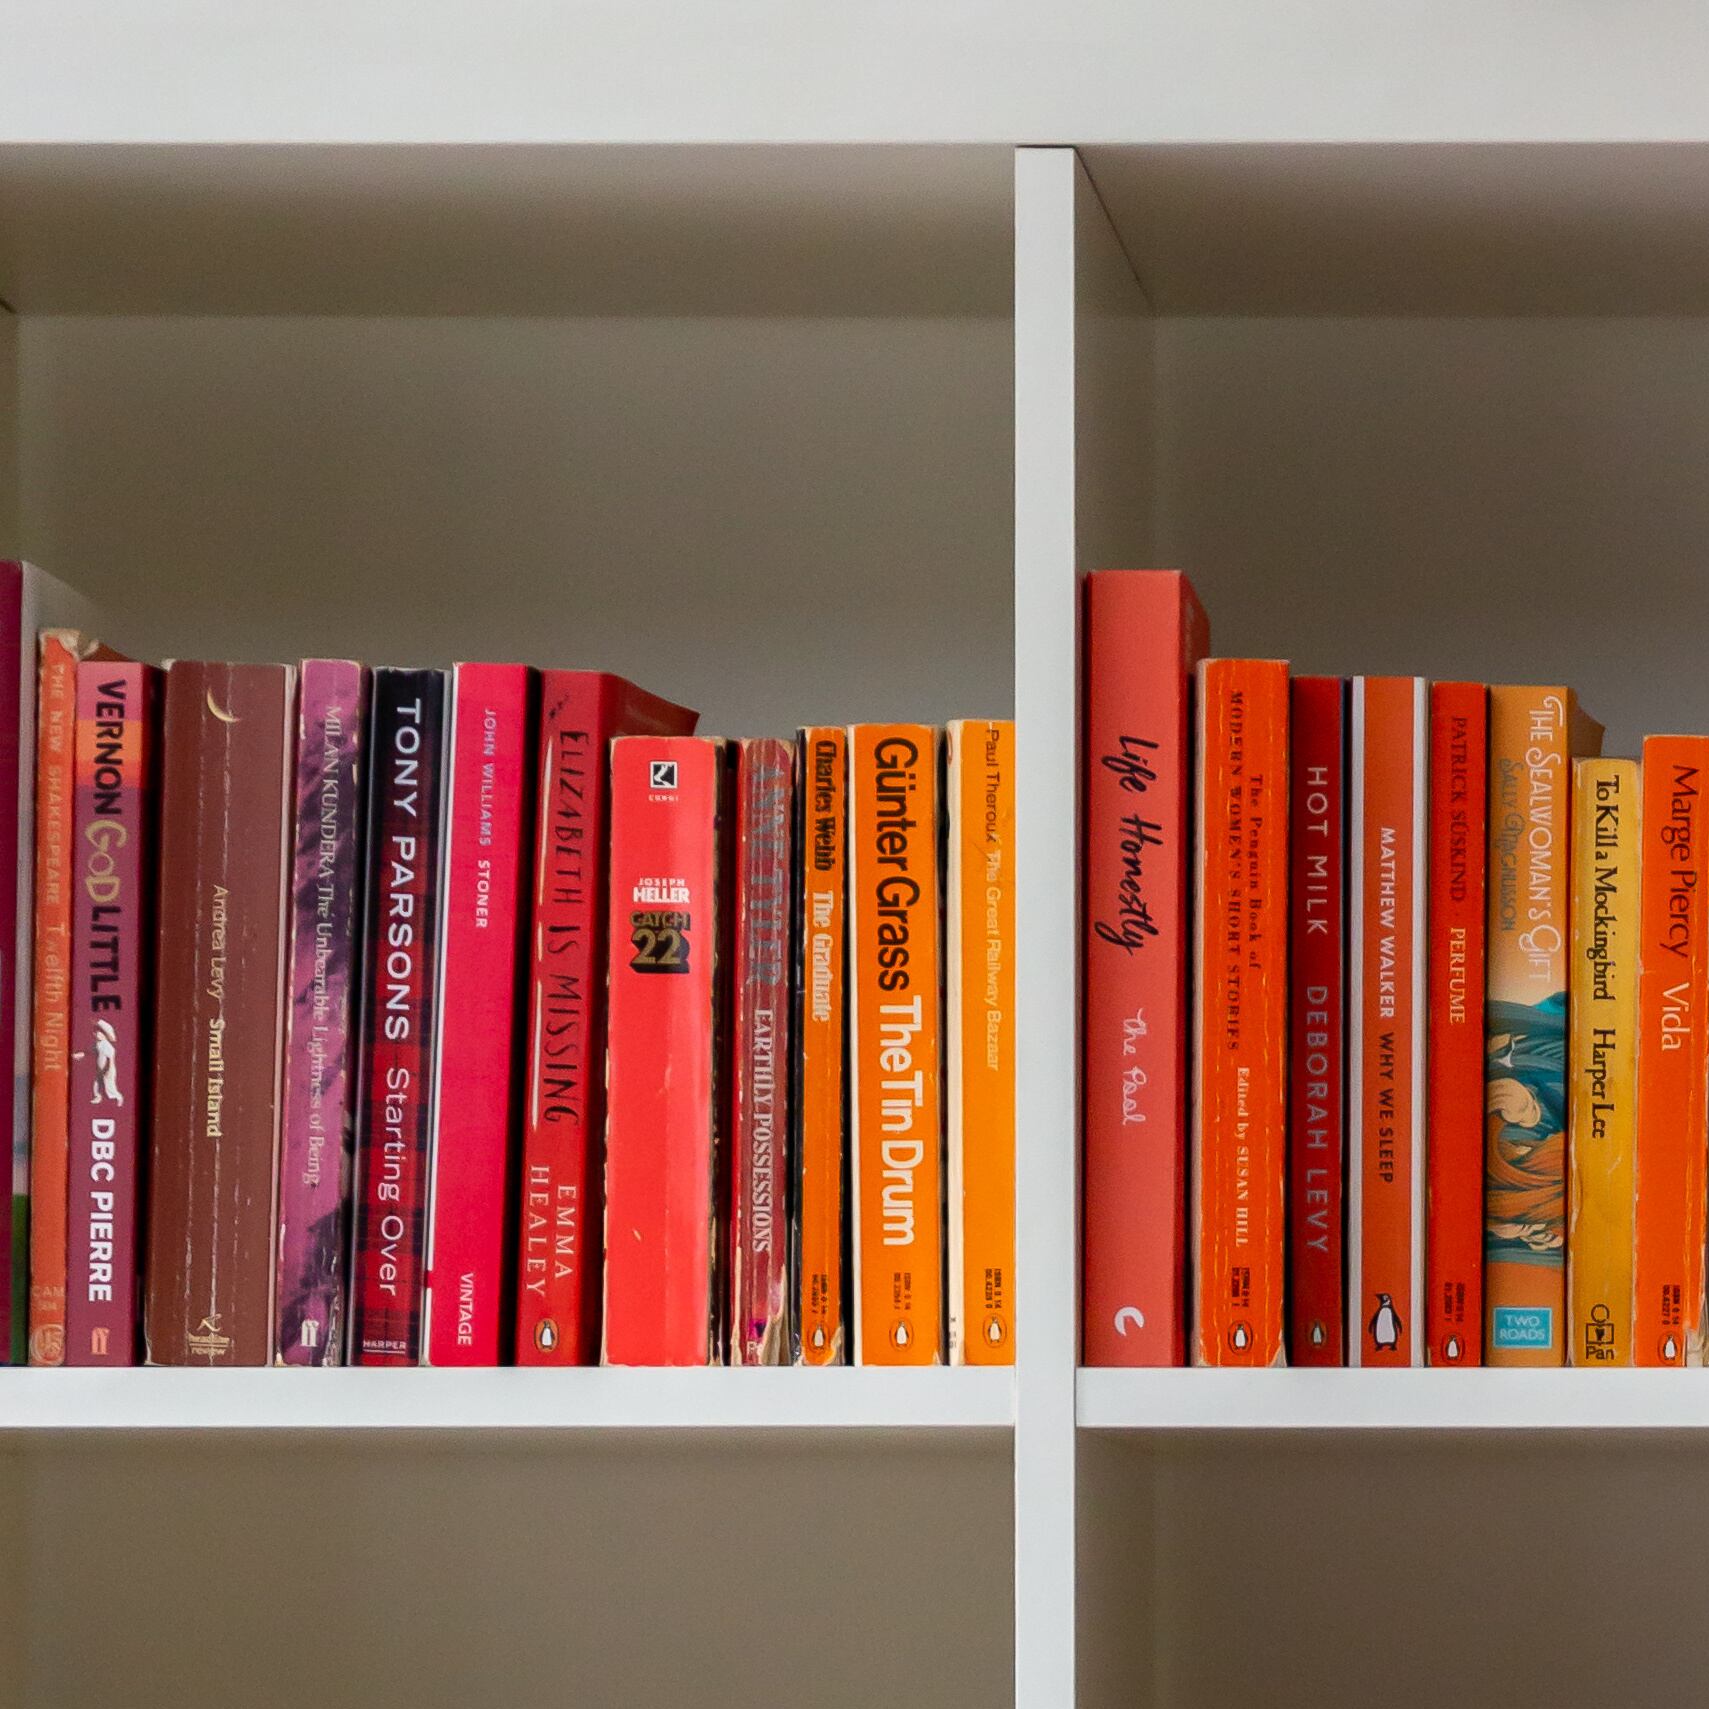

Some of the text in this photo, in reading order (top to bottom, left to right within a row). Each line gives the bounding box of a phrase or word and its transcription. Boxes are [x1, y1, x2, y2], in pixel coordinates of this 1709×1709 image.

[475, 709, 496, 928] JOHN WILLIAMS STONER
[378, 699, 422, 1297] TONY PARSONS Starting Over
[1305, 766, 1328, 1253] HOT MILK DEBORAH LEVY
[1378, 827, 1396, 1183] MATTHEW WALKER WHY WE SLEEP
[88, 1118, 115, 1302] DBC PIERRE
[457, 1272, 475, 1346] VINTAGE
